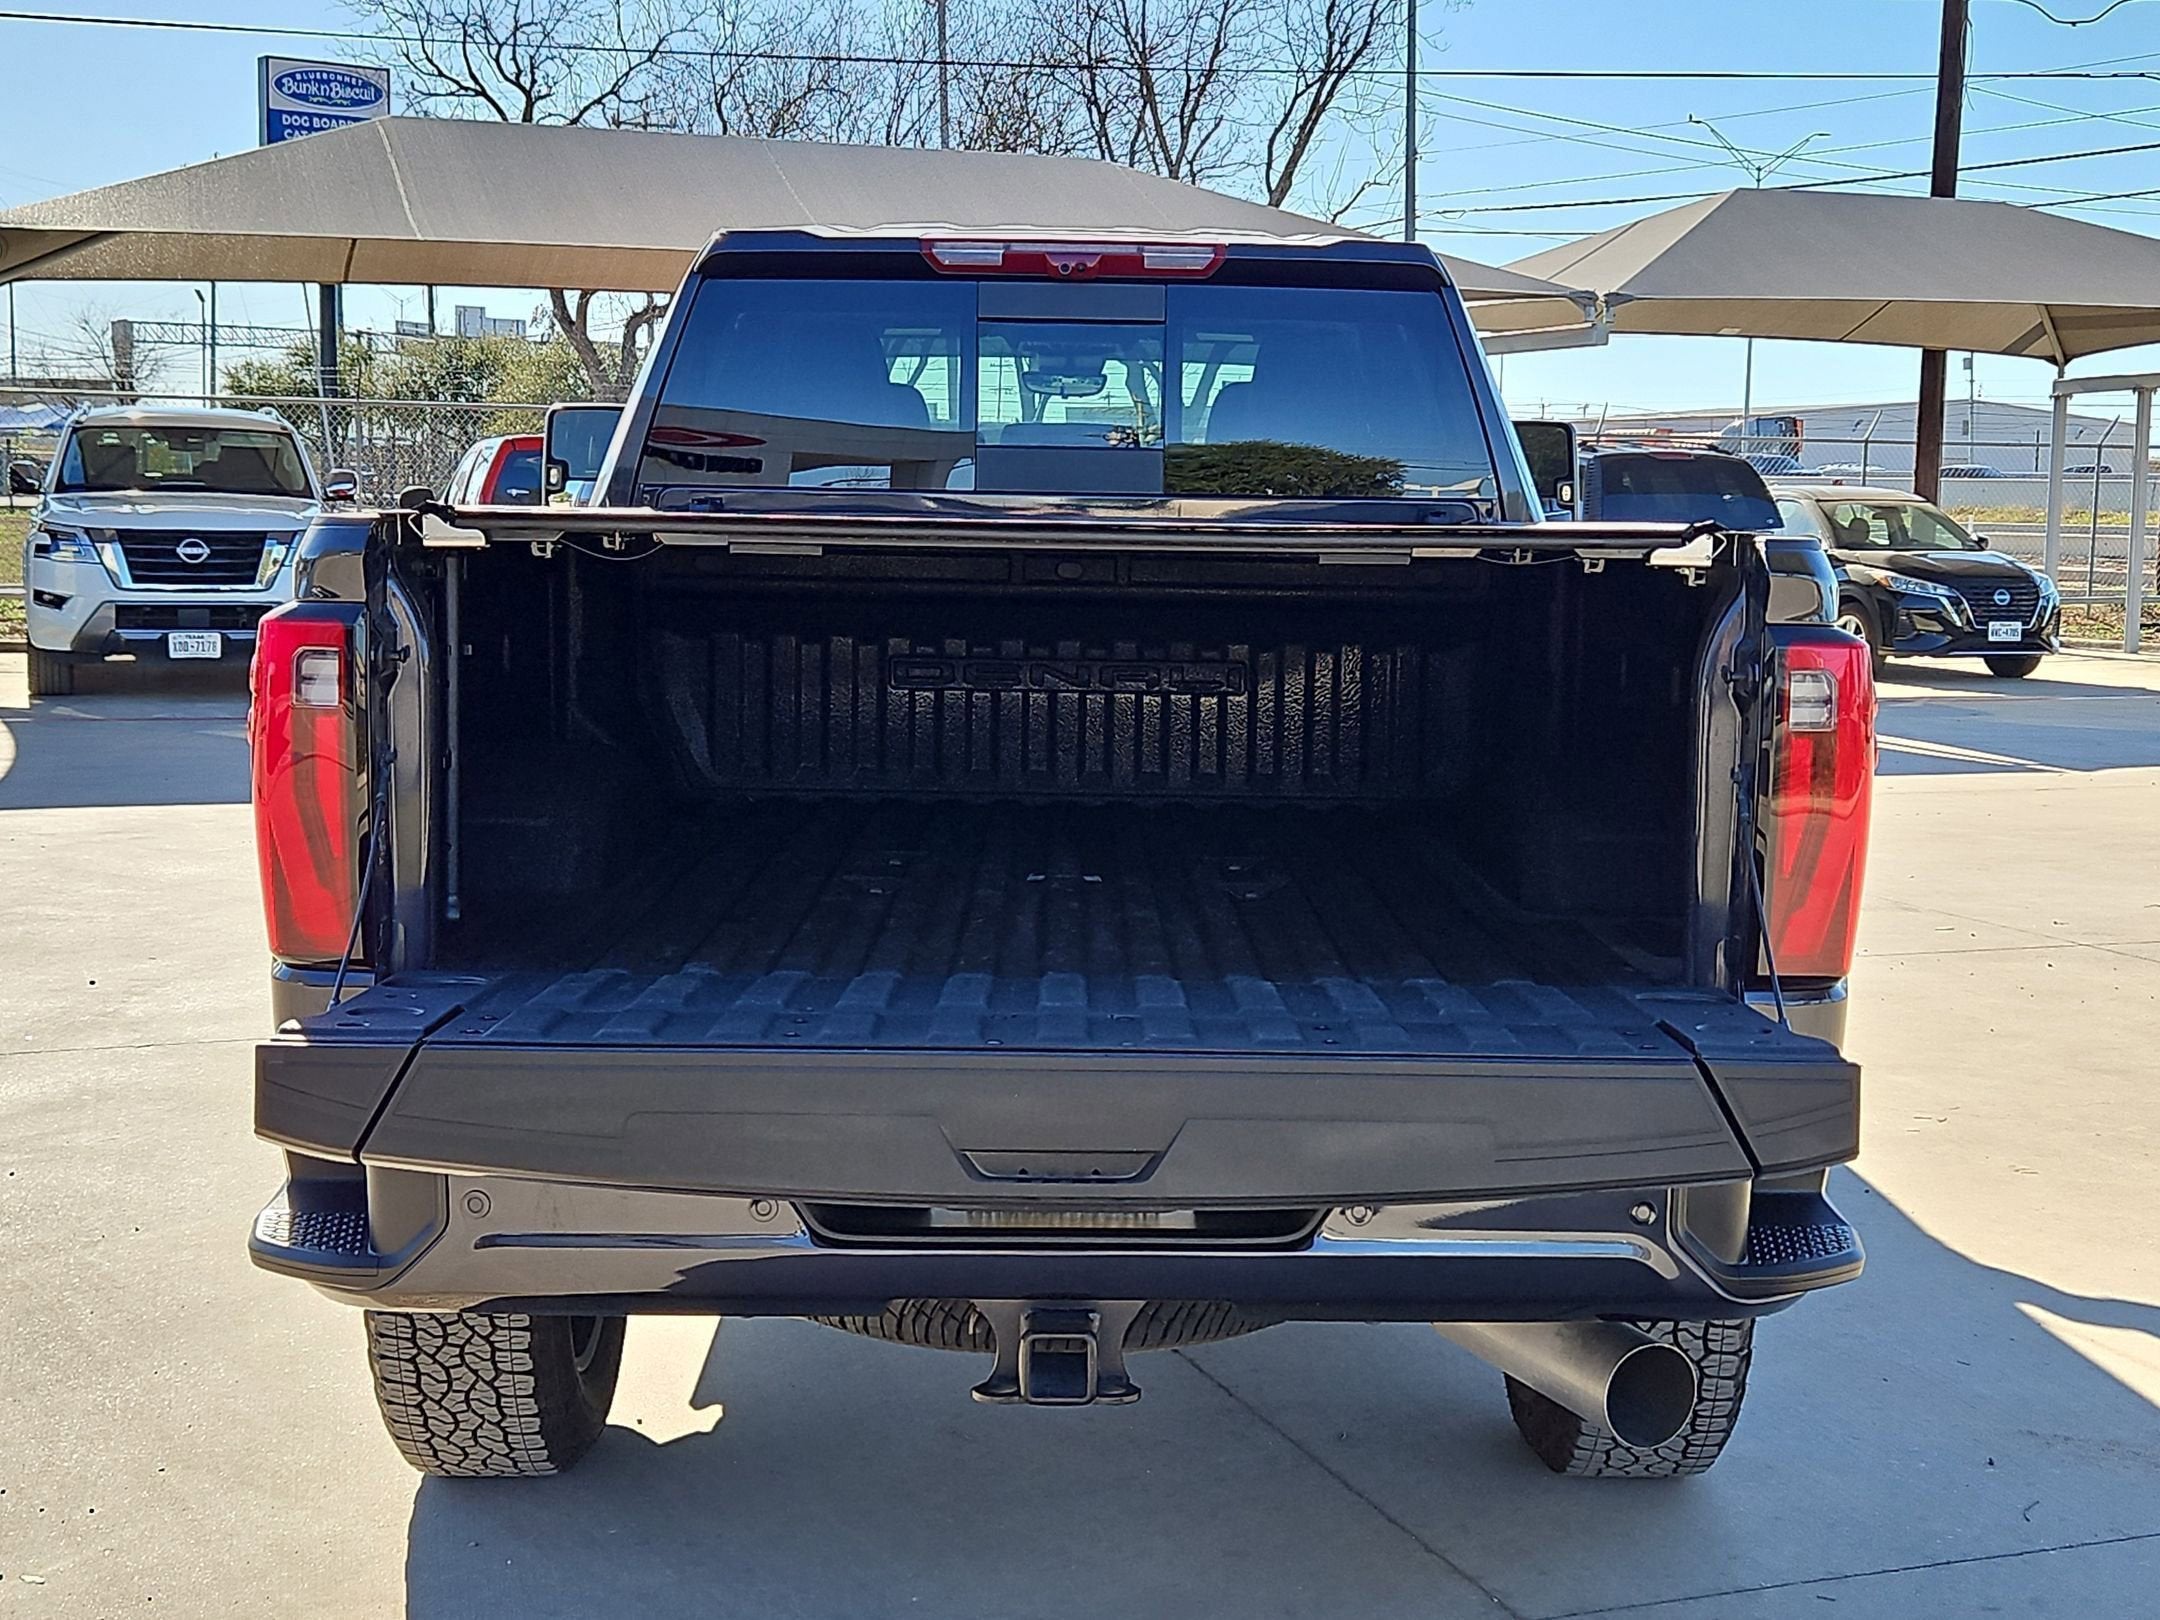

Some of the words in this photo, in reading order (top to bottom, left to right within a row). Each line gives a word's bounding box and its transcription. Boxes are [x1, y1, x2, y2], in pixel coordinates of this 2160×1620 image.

[295, 72, 363, 86] BLUEBONNET
[282, 114, 310, 127] DOG
[893, 661, 1246, 693] DENALI
